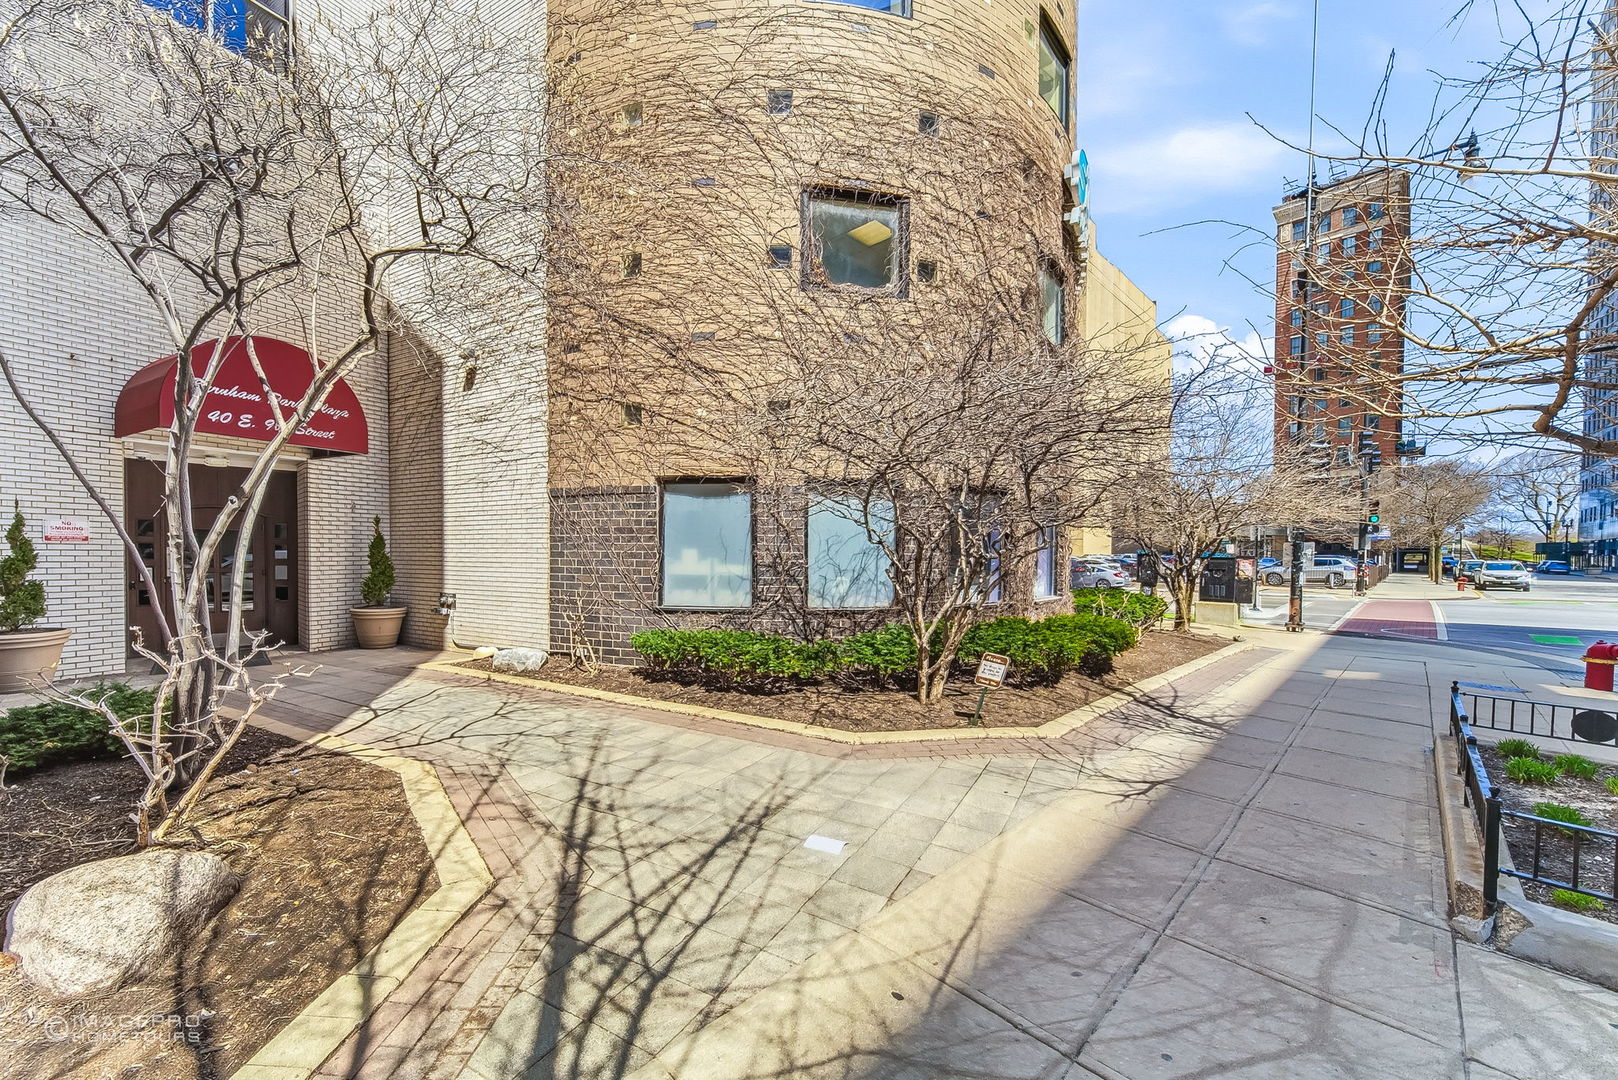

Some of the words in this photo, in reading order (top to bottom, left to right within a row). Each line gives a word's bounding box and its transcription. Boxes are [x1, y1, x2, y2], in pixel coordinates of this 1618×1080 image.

[205, 385, 262, 402] rnham
[267, 391, 299, 408] Par
[319, 402, 350, 420] laza
[207, 410, 233, 424] 40
[237, 413, 256, 428] E.
[295, 422, 336, 439] Street
